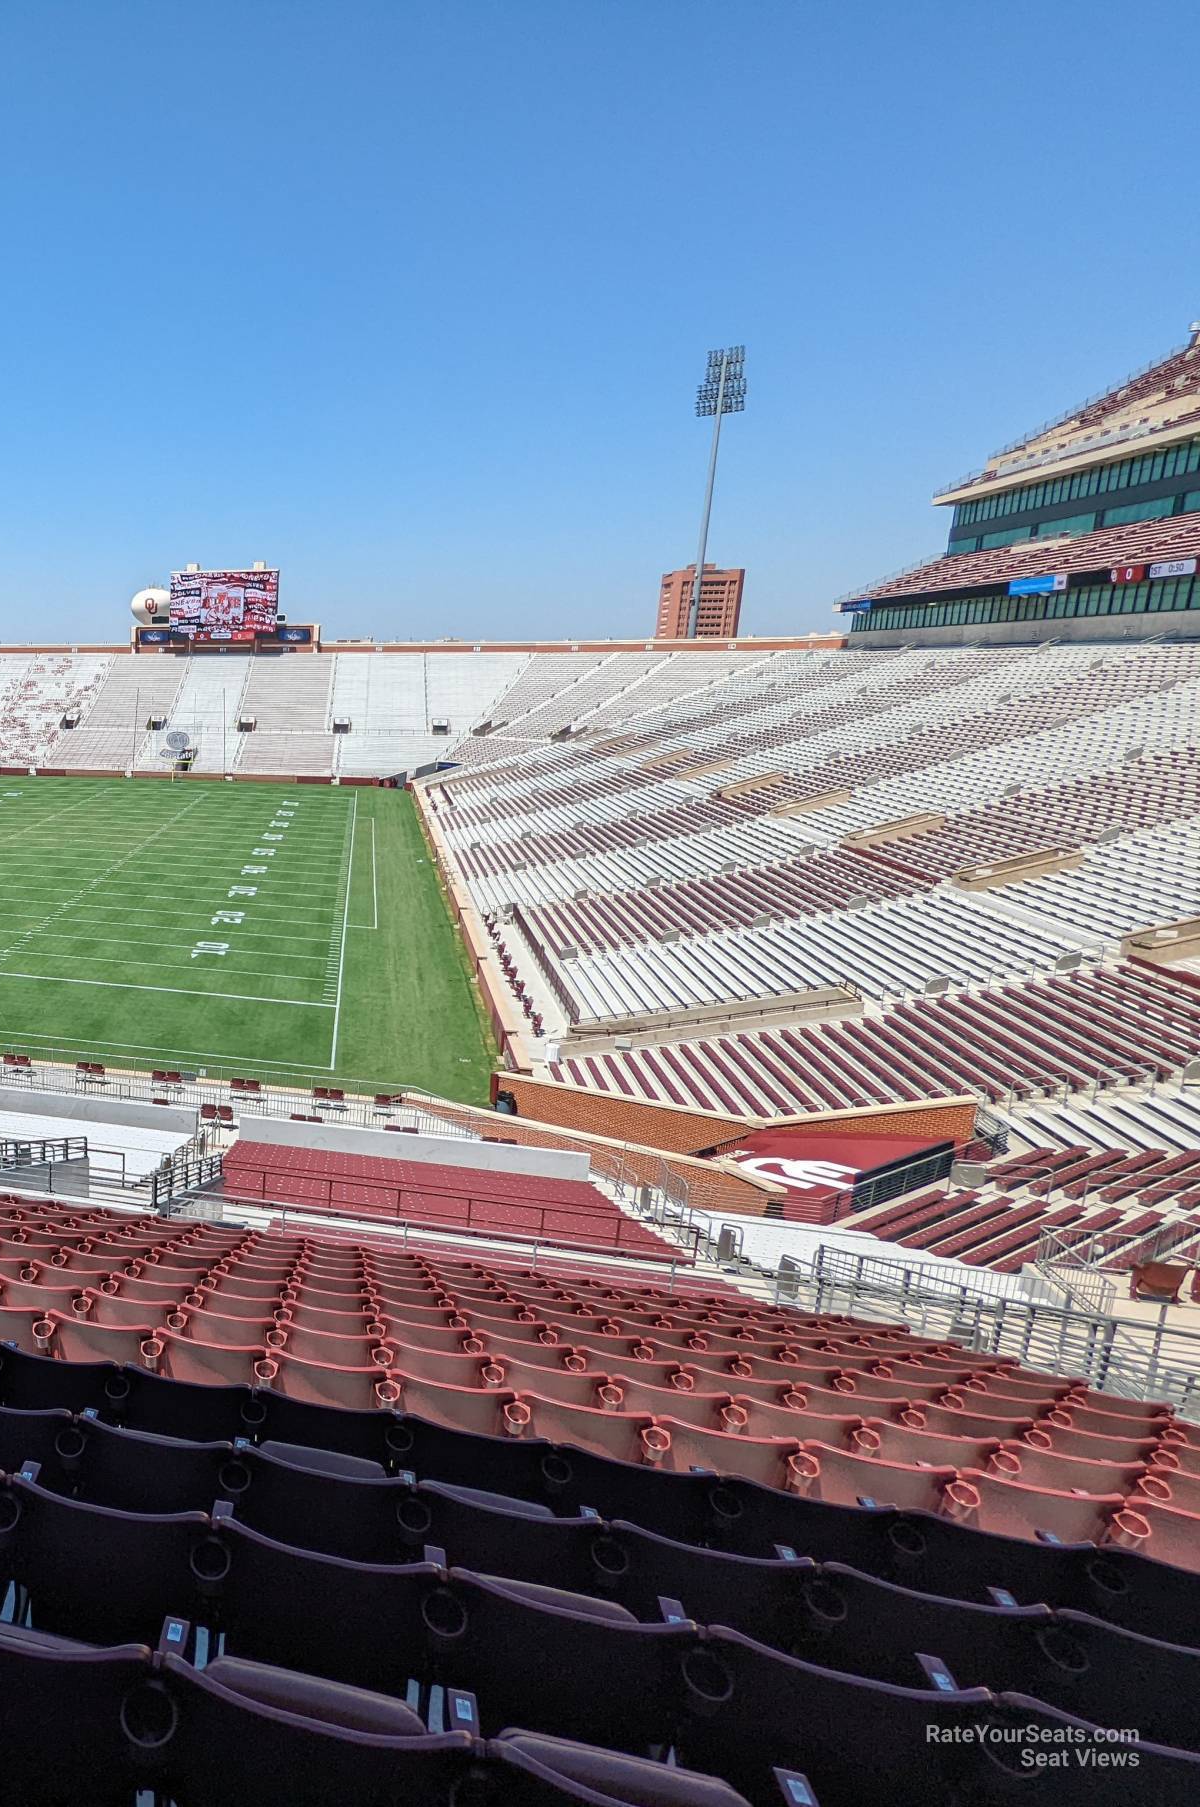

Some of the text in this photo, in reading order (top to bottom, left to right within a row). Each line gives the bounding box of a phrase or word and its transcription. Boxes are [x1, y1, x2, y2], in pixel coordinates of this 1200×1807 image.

[1125, 568, 1133, 580] 0
[1168, 562, 1185, 573] 0:30
[145, 598, 157, 614] OU
[211, 910, 245, 925] 20
[191, 941, 230, 959] 10
